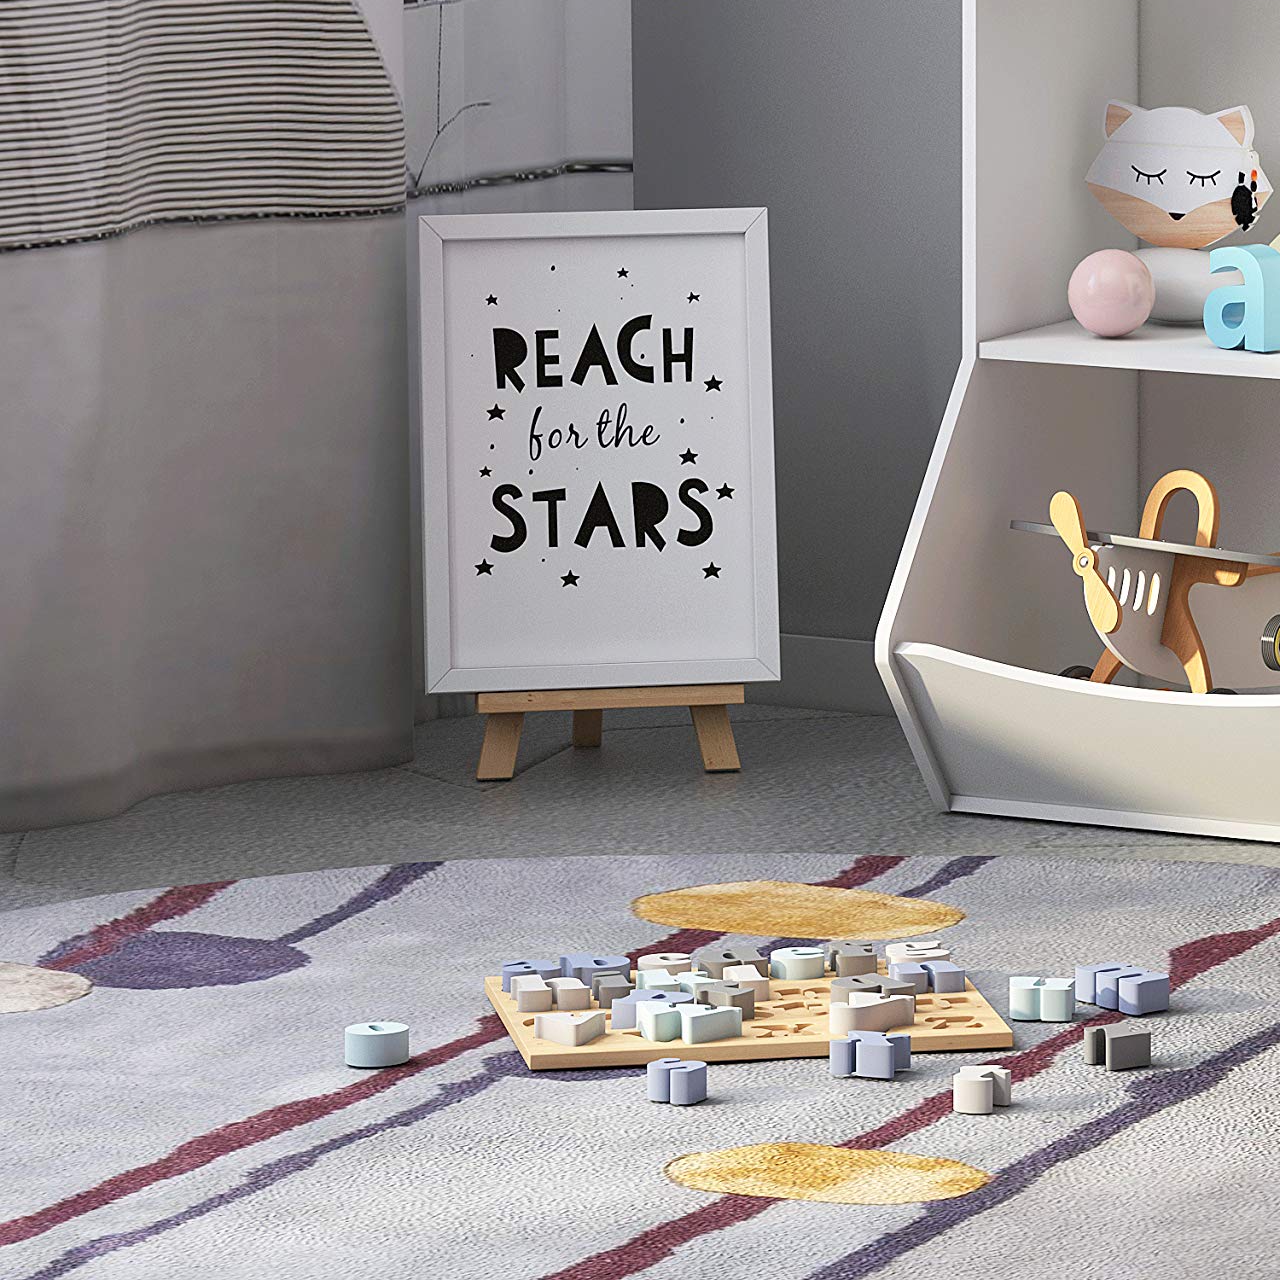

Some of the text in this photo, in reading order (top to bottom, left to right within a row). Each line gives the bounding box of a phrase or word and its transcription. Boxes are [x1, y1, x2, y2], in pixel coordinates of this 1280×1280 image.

[492, 314, 694, 394] REACH
[528, 402, 661, 462] for the
[490, 477, 715, 553] STARS
